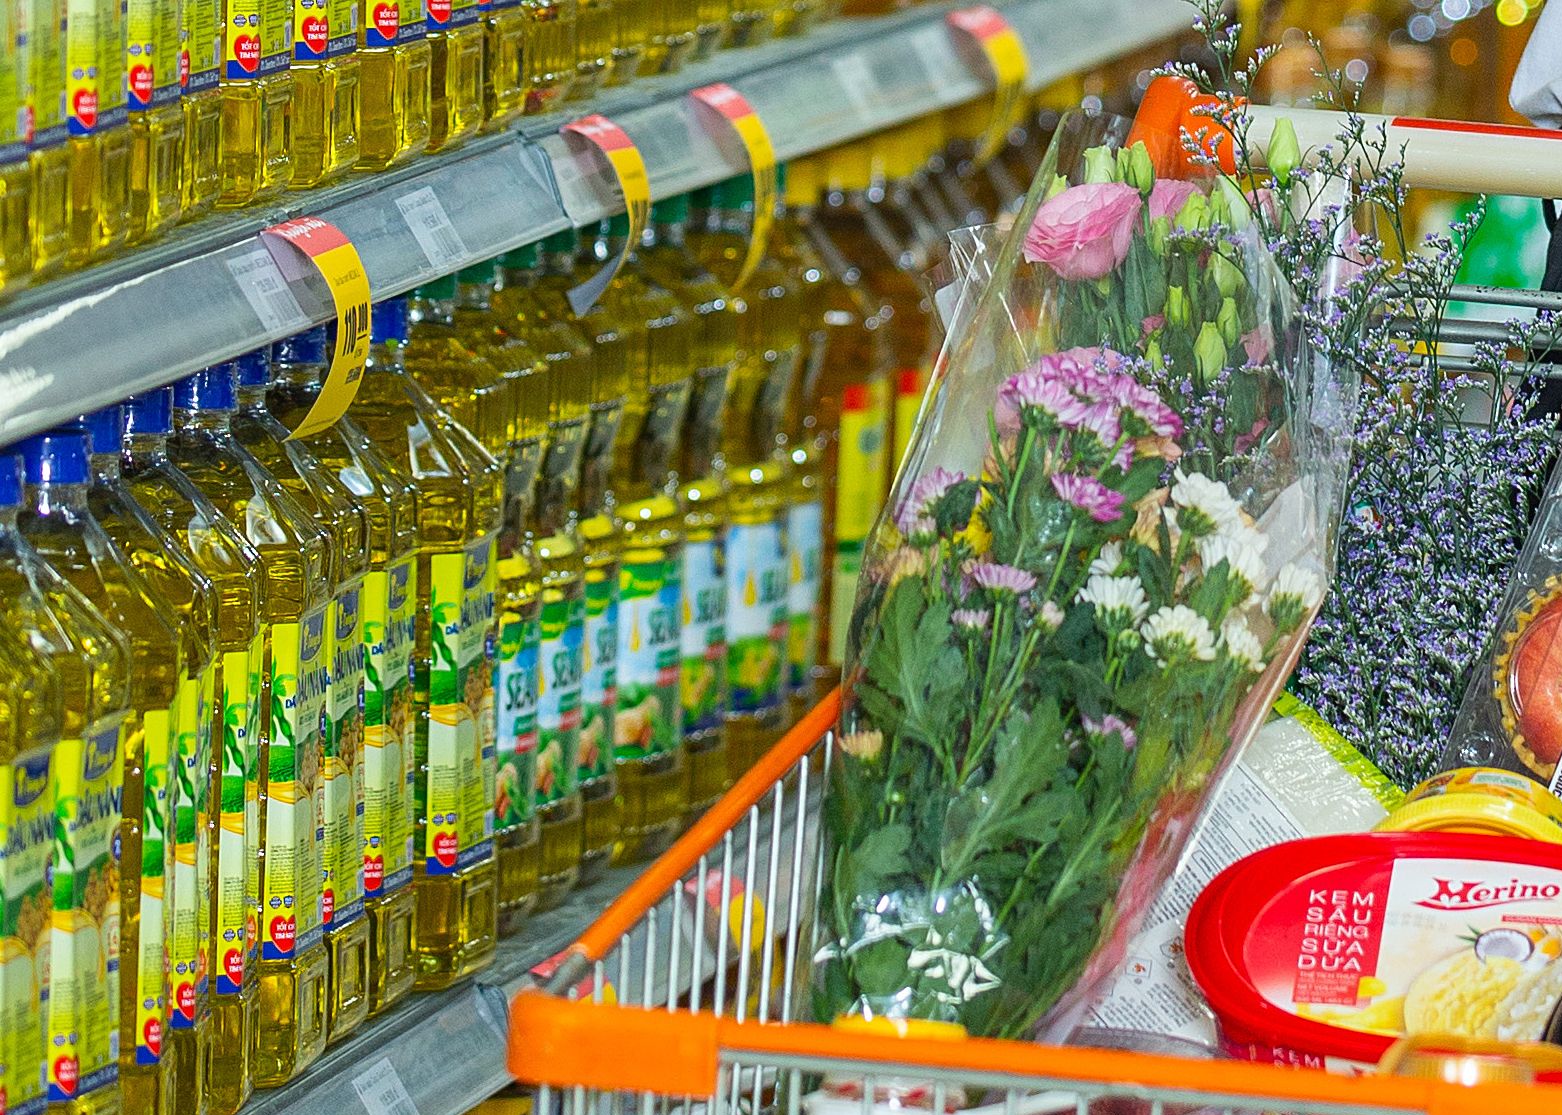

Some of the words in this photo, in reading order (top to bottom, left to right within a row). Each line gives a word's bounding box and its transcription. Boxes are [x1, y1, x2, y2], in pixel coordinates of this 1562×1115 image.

[1310, 889, 1375, 907] KEM
[1430, 877, 1560, 904] Merino
[1273, 1048, 1320, 1068] KEM
